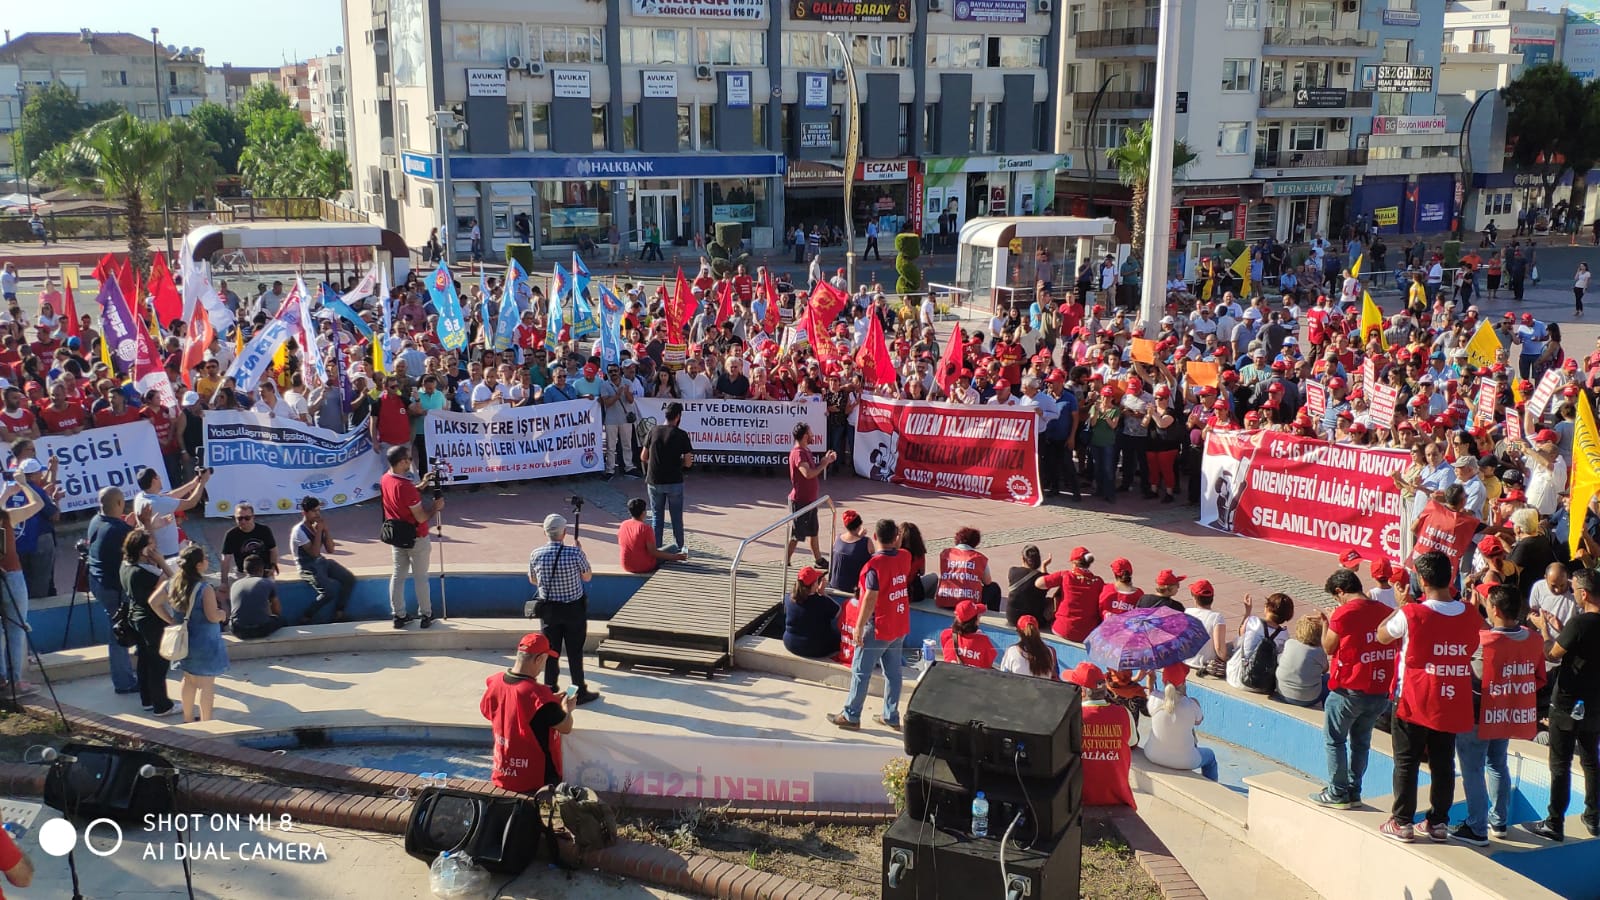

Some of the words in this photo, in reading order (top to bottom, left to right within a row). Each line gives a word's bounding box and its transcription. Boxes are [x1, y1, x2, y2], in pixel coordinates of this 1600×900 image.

[812, 2, 890, 16] GALATASARAY
[591, 161, 654, 173] HALKBANK
[866, 163, 906, 173] ECZANE
[1007, 159, 1033, 167] Garanti
[1304, 185, 1333, 193] EKMEK
[914, 183, 922, 230] ECZANE
[661, 403, 702, 412] ALET
[705, 404, 719, 413] VE
[721, 404, 783, 415] DEMOKRASİ
[786, 405, 808, 417] İÇİN
[434, 421, 478, 435] HAKSIZ
[482, 421, 513, 435] YERE
[517, 416, 550, 434] İŞTEN
[553, 409, 592, 429] ATILAN
[700, 415, 769, 428] NÖBETTEYİZ!
[905, 413, 942, 436] KIDEM
[209, 427, 281, 441] Yoksullaşmaya,
[688, 433, 713, 444] ATILAN
[718, 431, 741, 443] ALİAĞA
[743, 432, 773, 447] İŞÇİLERİ
[774, 432, 792, 444] GERİ
[434, 440, 472, 459] ALİAĞA
[475, 440, 516, 460] İŞÇİLERİ
[519, 438, 554, 455] YALNIZ
[556, 431, 597, 450] DEĞİLDİR
[211, 444, 277, 464] Birlikte
[715, 455, 726, 463] VE
[727, 455, 780, 465] DEMOKRASİ
[904, 442, 957, 466] EMEKLİLİK
[961, 449, 1025, 470] HAKKIMIZA
[1270, 439, 1300, 461] 15-16
[1303, 444, 1357, 471] HAZİRAN
[460, 466, 483, 474] İZMİR
[485, 462, 521, 473] GENEL-İŞ
[553, 459, 572, 468] ŞUBE
[301, 478, 335, 490] KESK
[904, 468, 933, 483] SAHİP
[935, 472, 994, 495] ÇIKIYORUZ
[1252, 465, 1318, 502] DİRENİŞTEKİ
[1317, 476, 1355, 509] ALİAĞA
[1251, 506, 1373, 548] SELAMLIYORUZ
[896, 602, 905, 614] İŞ
[1366, 628, 1378, 644] Dİ
[957, 646, 981, 660] DİSK
[1433, 641, 1468, 656] DİSK
[1372, 667, 1386, 682] İŞ
[1425, 662, 1471, 677] GENEL
[1440, 683, 1455, 699] İŞ
[1095, 740, 1121, 749] YOKTUR
[509, 758, 529, 768] SEN
[1081, 751, 1119, 760] ALİAĞA
